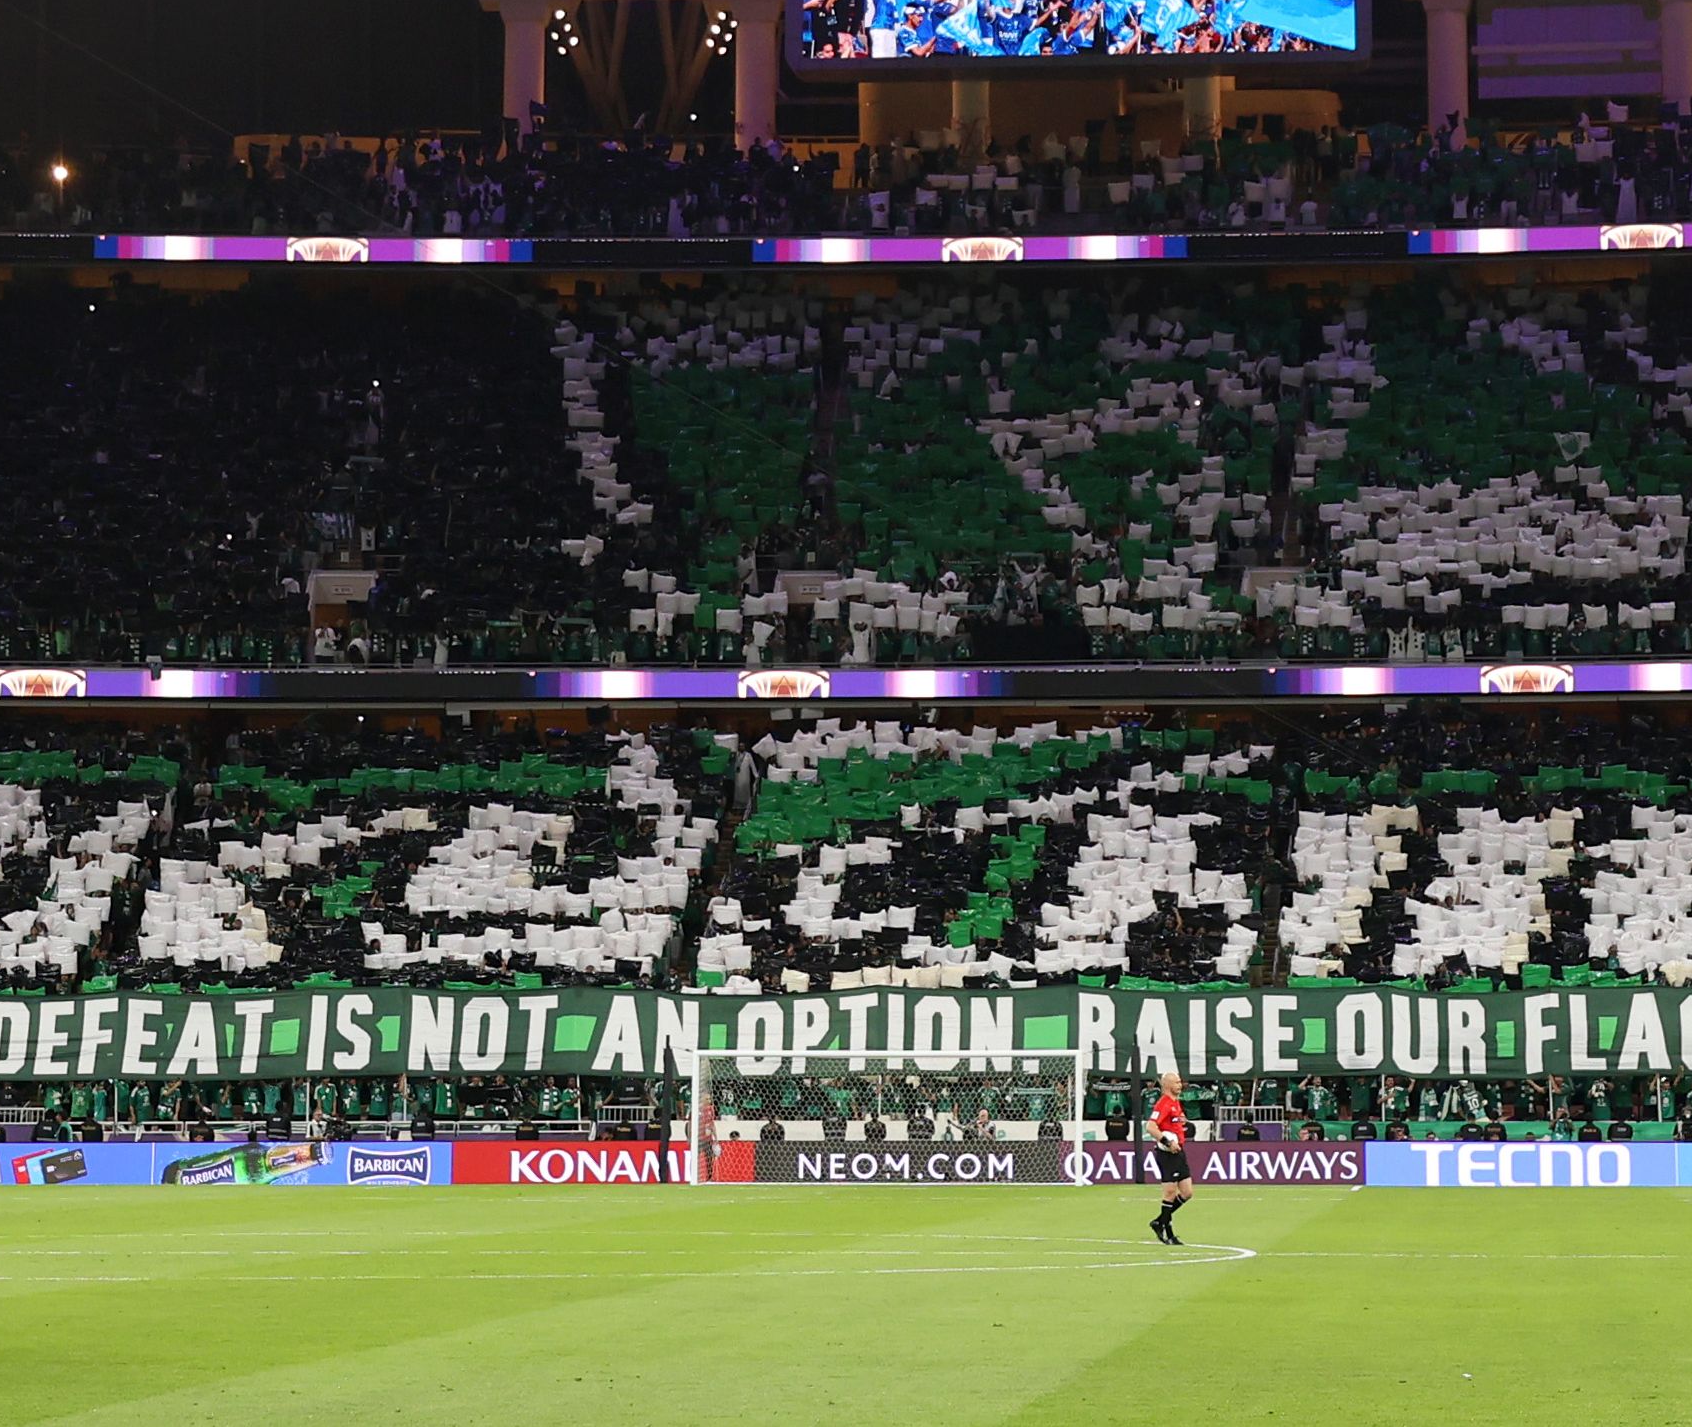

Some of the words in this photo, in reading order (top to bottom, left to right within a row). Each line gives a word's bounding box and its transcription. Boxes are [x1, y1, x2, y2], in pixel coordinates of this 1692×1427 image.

[306, 994, 374, 1071] IS
[408, 994, 559, 1071] NOT
[591, 994, 700, 1074] AN
[1078, 992, 1299, 1074] RAISE
[1336, 991, 1487, 1075] OUR
[182, 1163, 233, 1185] BARBICAN
[354, 1157, 424, 1173] BARBICAN
[797, 1152, 1014, 1180] NEOM.COM
[1064, 1150, 1161, 1186] QATA
[1202, 1150, 1359, 1180] AIRWAYS
[1410, 1143, 1631, 1187] TECNO
